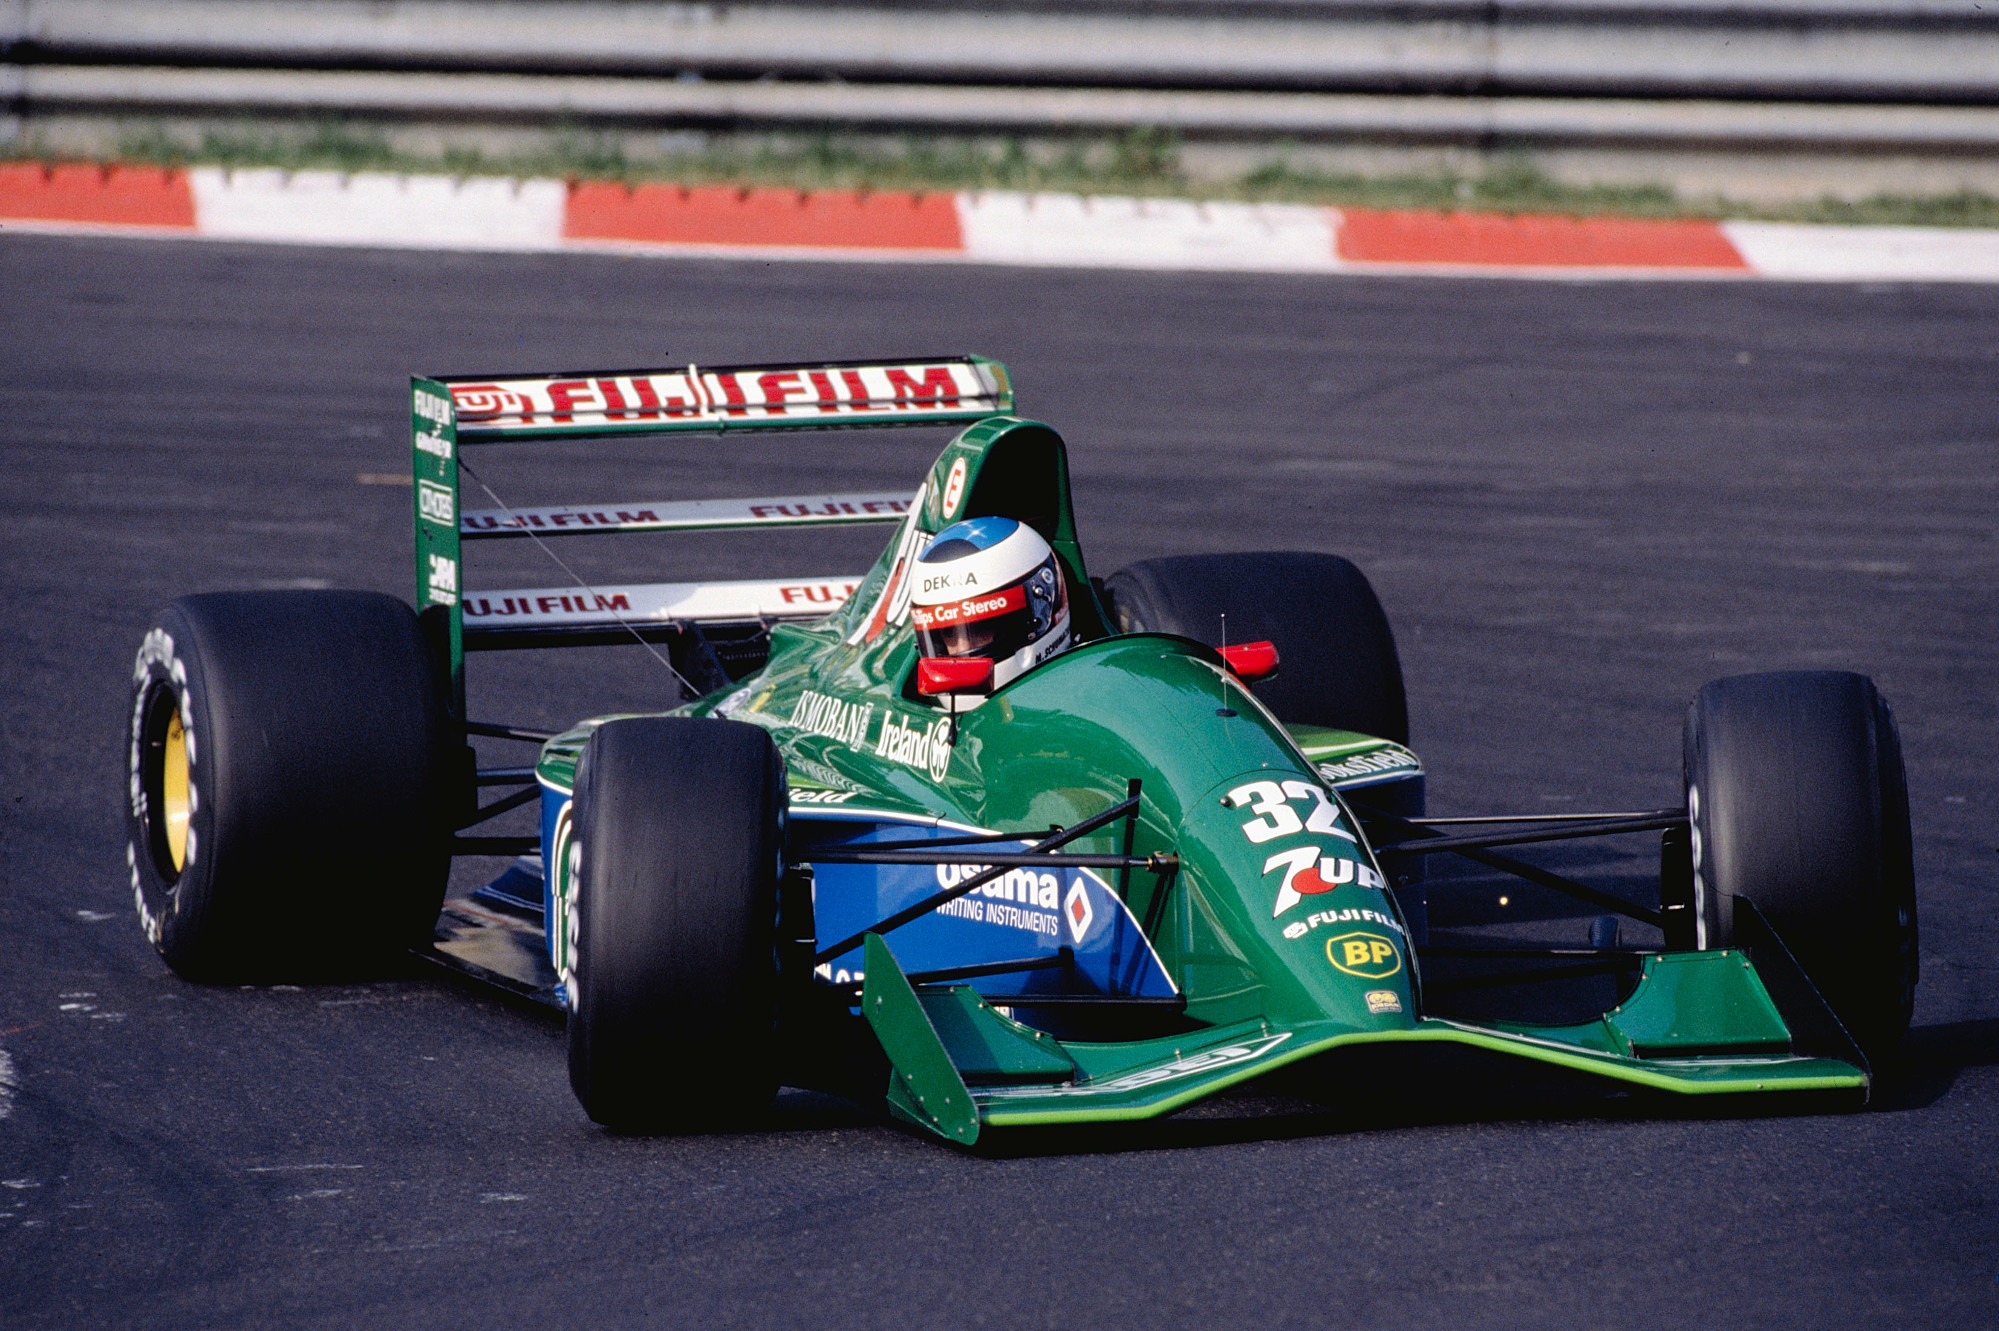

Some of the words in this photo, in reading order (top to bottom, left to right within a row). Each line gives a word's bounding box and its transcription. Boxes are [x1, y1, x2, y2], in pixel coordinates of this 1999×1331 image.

[923, 572, 978, 593] DEKA
[934, 605, 959, 622] Car
[961, 596, 1007, 617] Stereo
[875, 710, 933, 770] Ireland
[1227, 780, 1358, 844] 32
[936, 896, 983, 922] WRITING
[986, 903, 1058, 936] INSTRUMENTS
[1342, 941, 1393, 966] BP
